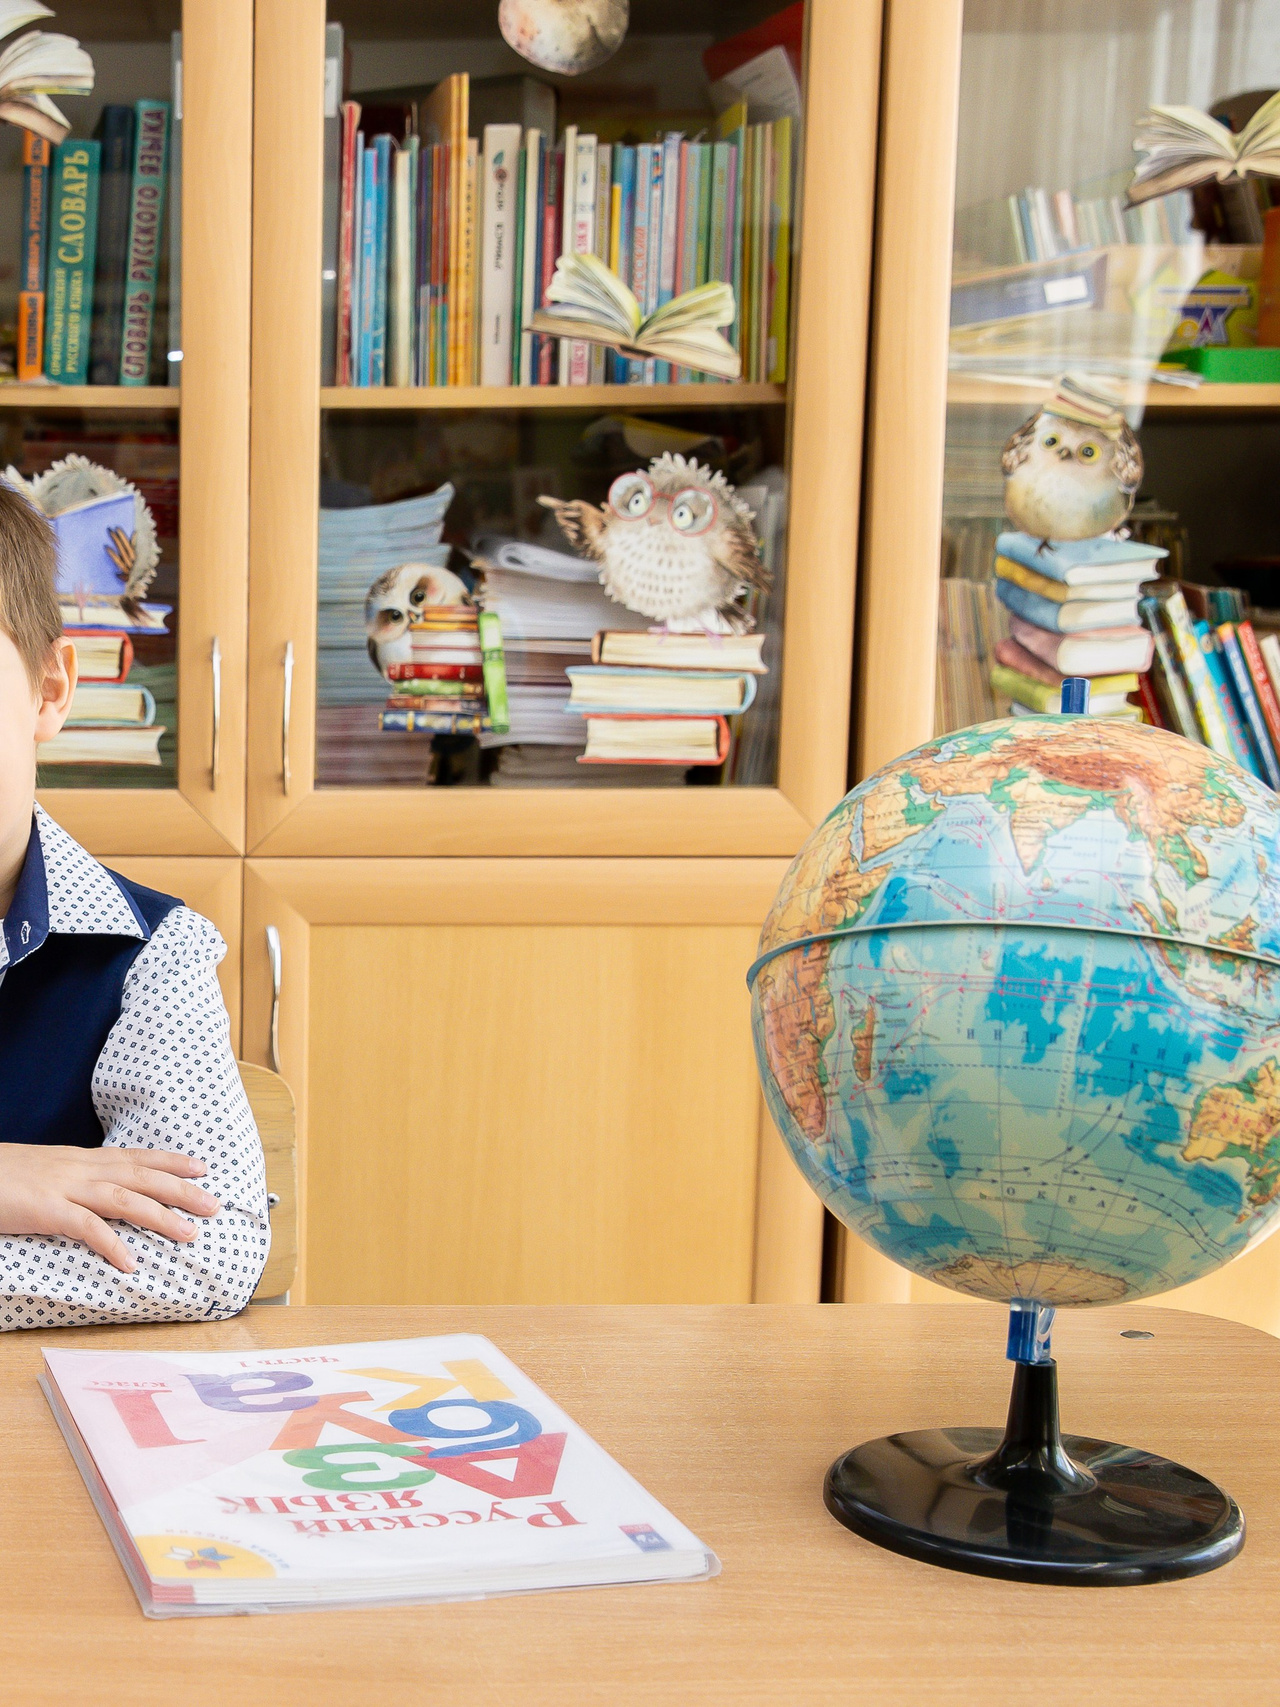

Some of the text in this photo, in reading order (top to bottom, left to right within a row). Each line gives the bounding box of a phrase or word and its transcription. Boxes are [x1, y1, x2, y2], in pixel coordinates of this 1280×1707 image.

[29, 165, 43, 231] РУССКОГО
[58, 149, 90, 264] СЛОВАРЬ
[27, 233, 41, 291] СЛОВАРЬ
[123, 107, 167, 379] СЛОВАРЬ РУССКОГО ЯЗЫКА
[66, 269, 84, 373] РУССКОГО ЯЗЫКА
[1006, 1186, 1138, 1214] ОКЕАН
[94, 1387, 207, 1450] 1
[285, 1500, 587, 1539] Русский
